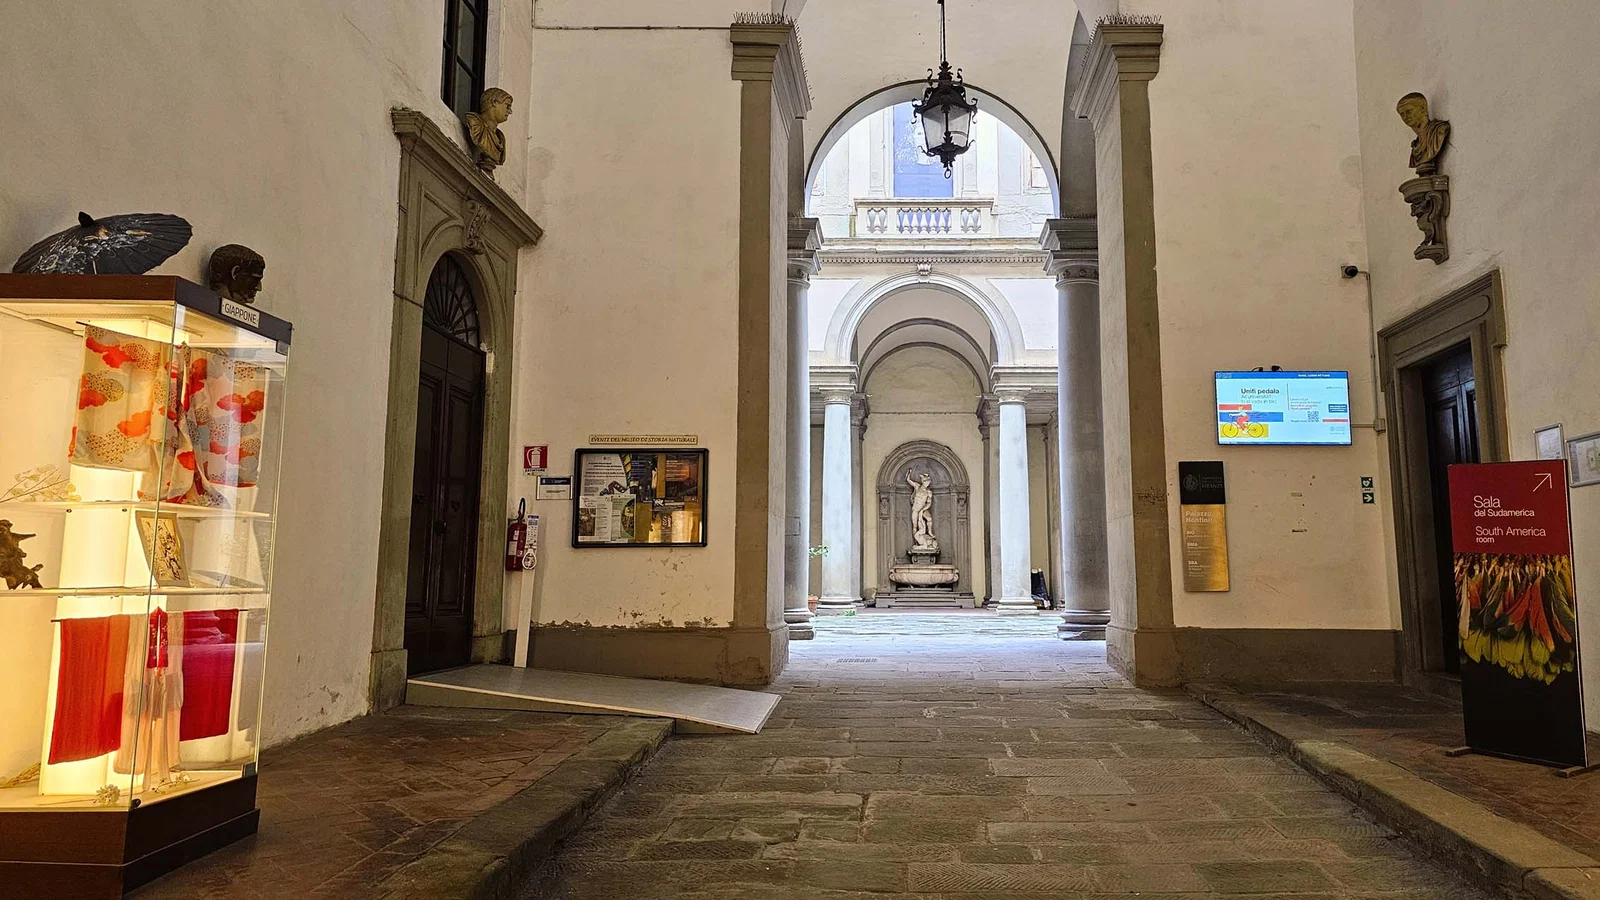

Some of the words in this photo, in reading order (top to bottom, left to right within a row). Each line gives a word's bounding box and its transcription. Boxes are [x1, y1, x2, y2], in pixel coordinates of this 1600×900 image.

[224, 303, 257, 324] GIAPPONE
[1473, 495, 1501, 509] Sala
[1474, 508, 1486, 517] del
[1487, 508, 1535, 517] Sudamerica
[1475, 525, 1504, 537] South
[1506, 526, 1546, 537] America
